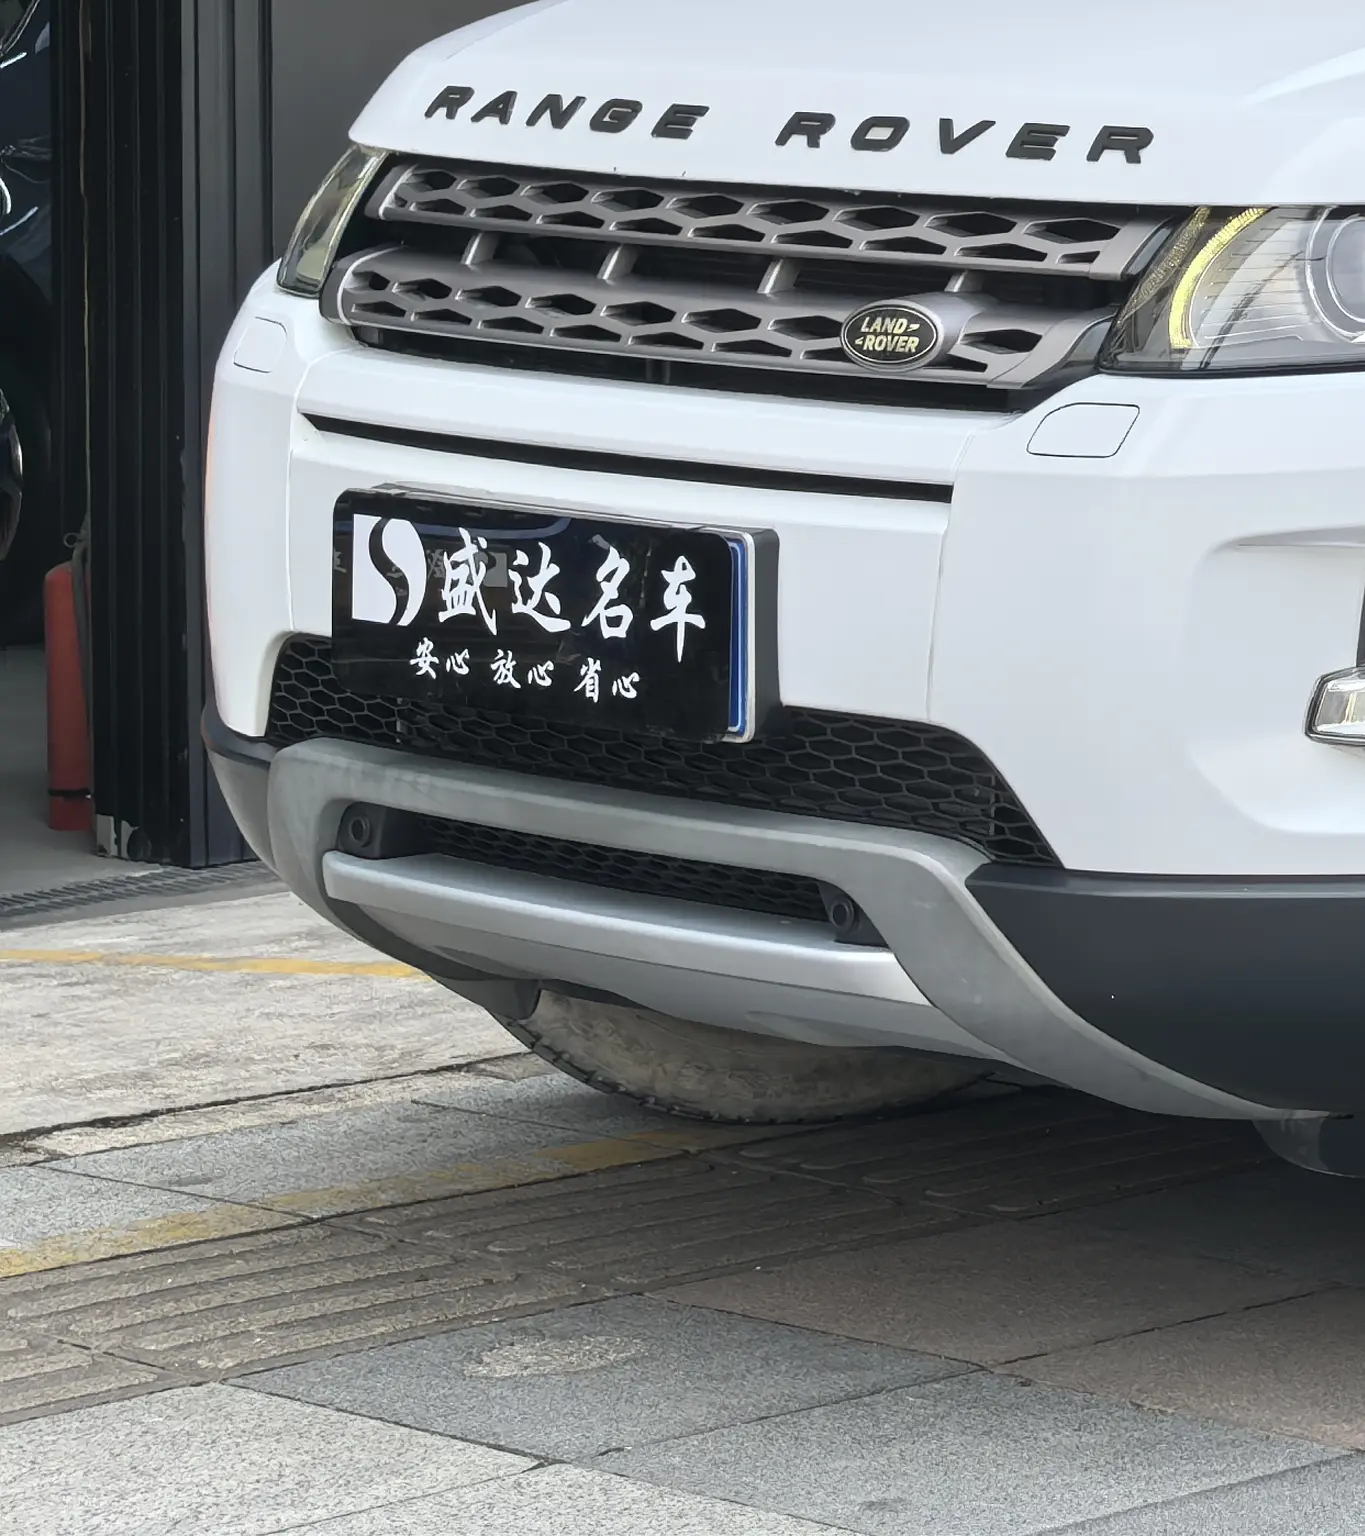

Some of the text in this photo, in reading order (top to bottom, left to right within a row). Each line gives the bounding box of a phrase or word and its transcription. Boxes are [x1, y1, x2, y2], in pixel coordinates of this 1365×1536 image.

[424, 85, 1154, 164] RANGE ROVER
[860, 316, 908, 334] LAND
[863, 334, 920, 353] ROVER
[438, 528, 706, 662] 盛达名车
[409, 637, 640, 703] 安心 放心 省心
